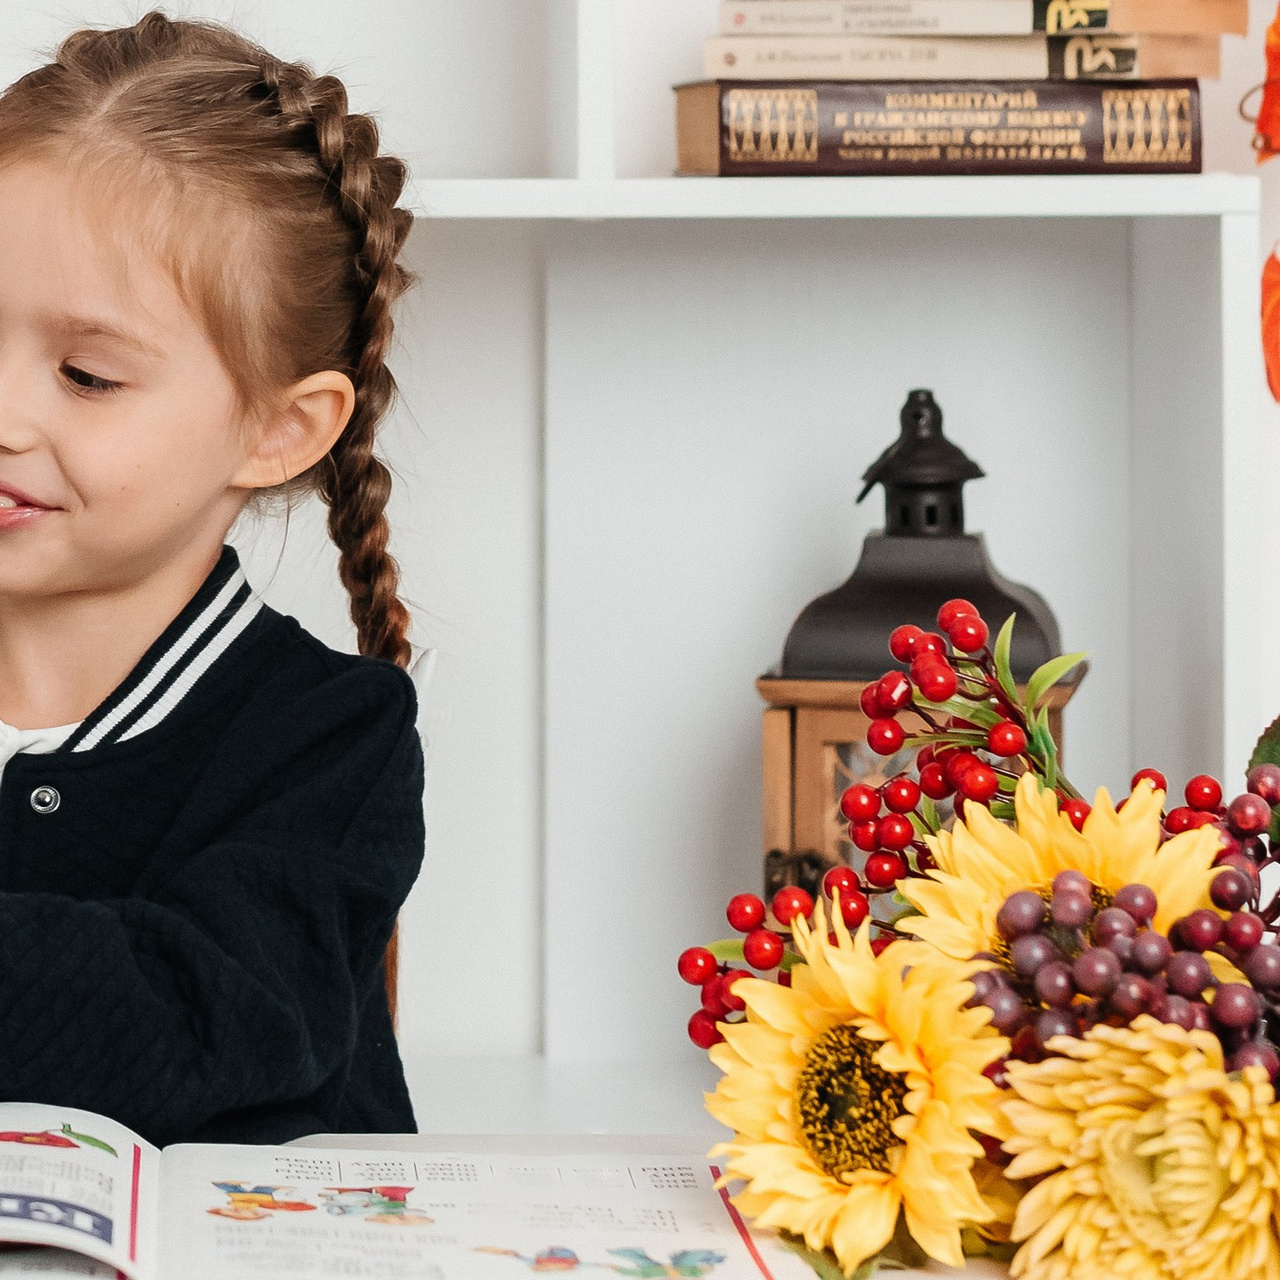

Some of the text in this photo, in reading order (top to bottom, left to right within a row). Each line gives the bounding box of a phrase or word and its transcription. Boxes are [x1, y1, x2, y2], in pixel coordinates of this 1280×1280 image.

[885, 89, 1038, 109] КОММЕНТАРИЙ
[853, 111, 1000, 128] ГРАЖДАНСКОМУ
[842, 127, 1081, 146] РОССИЙСКОЙ ФЕДЕРАЦИИ
